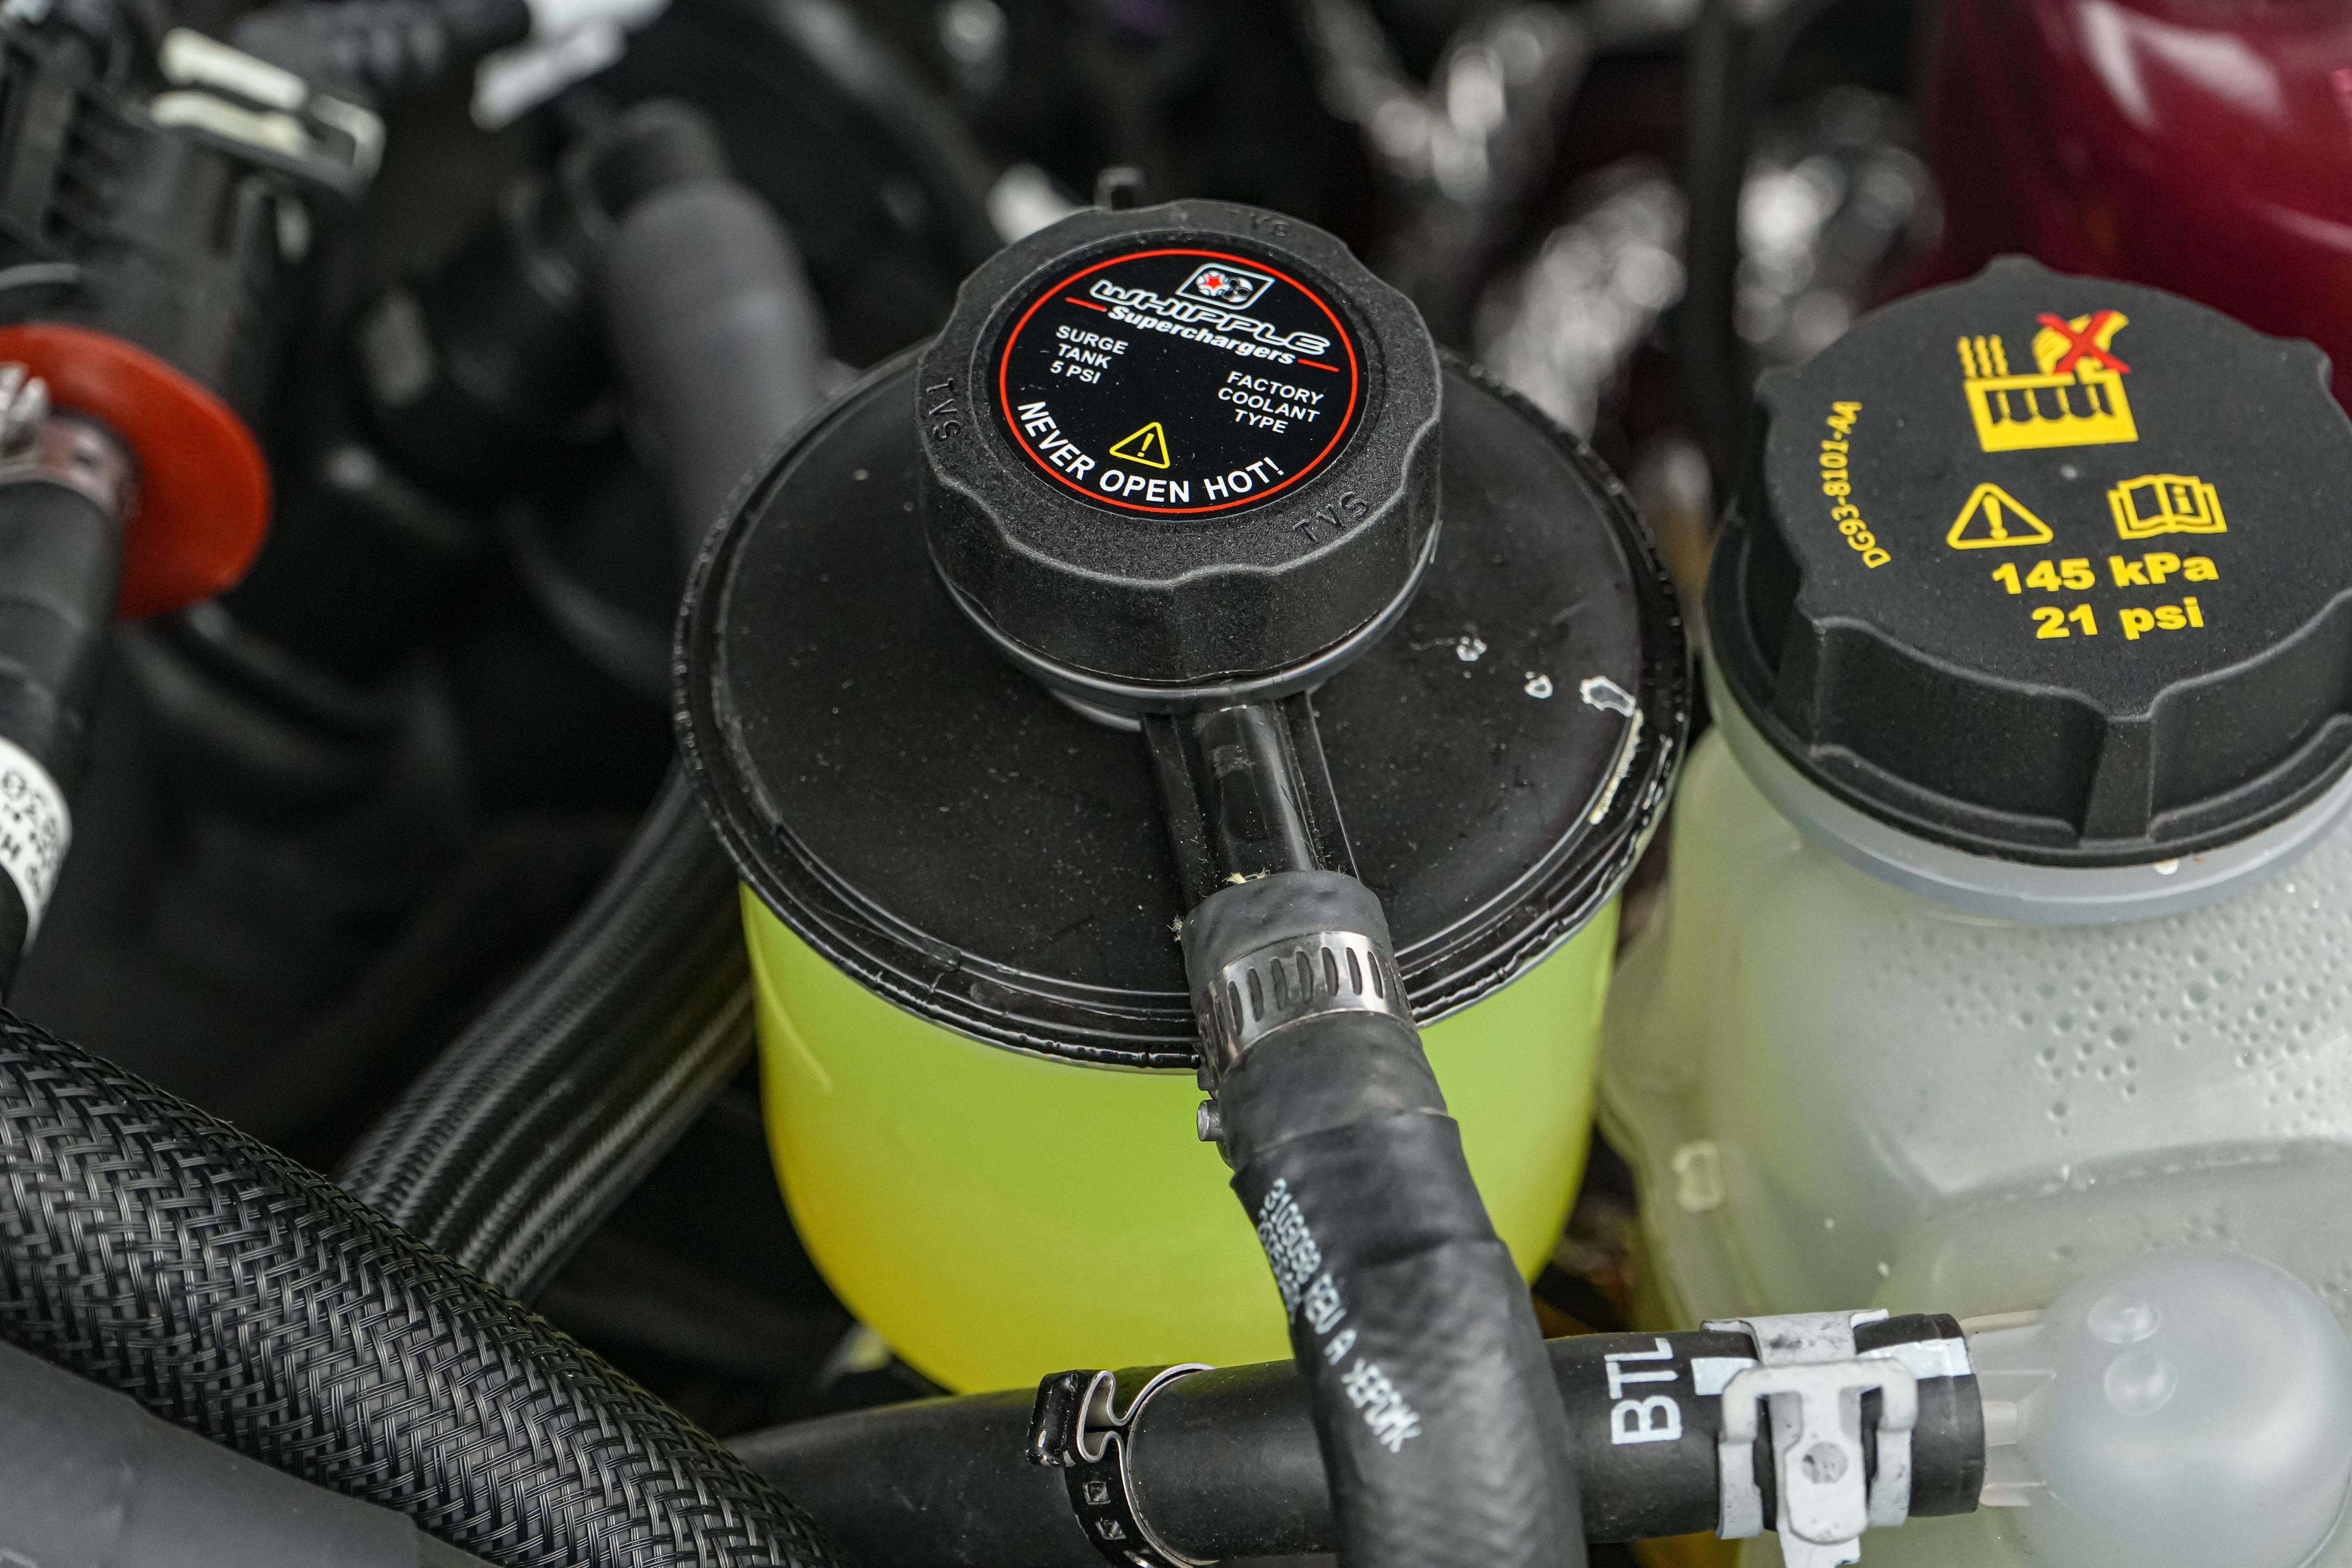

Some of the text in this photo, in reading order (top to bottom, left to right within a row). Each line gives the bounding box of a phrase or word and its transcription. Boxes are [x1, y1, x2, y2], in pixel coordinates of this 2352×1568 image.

[1090, 279, 1330, 355] WHIPPLE
[1108, 305, 1296, 365] Superchargers
[1056, 325, 1129, 355] SURGE
[1059, 343, 1112, 369] TANK
[1050, 361, 1101, 384] 5 PSI
[1226, 371, 1324, 405] FACTORY
[1218, 387, 1320, 423] COOLANT
[1234, 409, 1288, 433] TYPE
[1018, 401, 1284, 503] NEVER OPEN HOT!
[1292, 491, 1368, 544] TVS
[1992, 552, 2219, 595] 145 kPa
[2031, 596, 2204, 640] 21 psi
[1603, 1337, 1683, 1445] BTL
